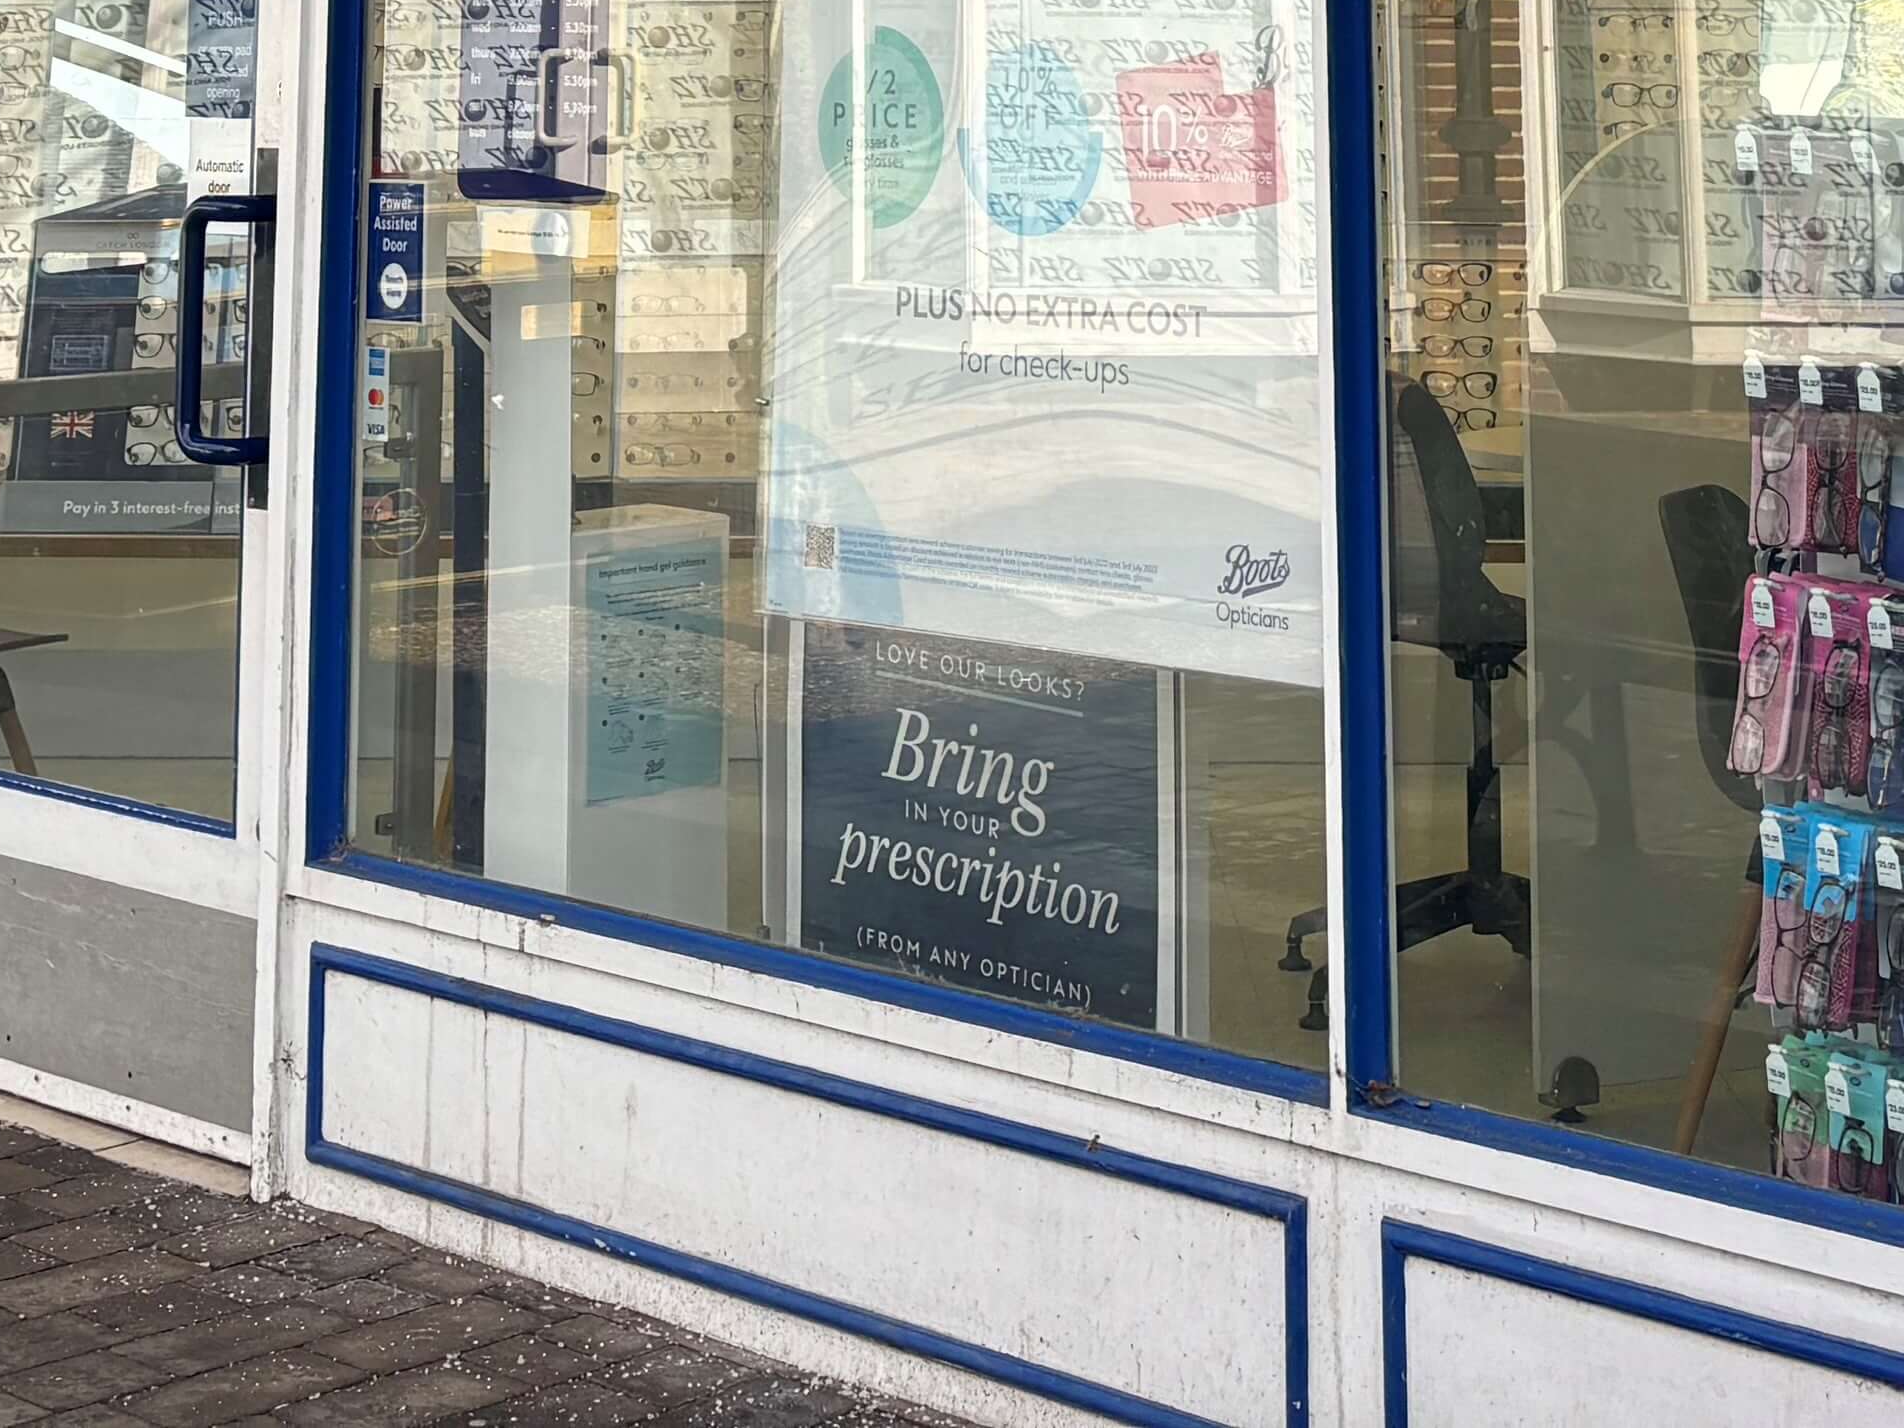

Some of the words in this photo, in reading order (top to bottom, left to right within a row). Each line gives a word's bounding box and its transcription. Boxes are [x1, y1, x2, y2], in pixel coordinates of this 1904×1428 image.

[471, 23, 490, 33] wed
[470, 73, 481, 85] fri
[563, 74, 597, 87] 5.30pm
[206, 87, 240, 101] opening
[833, 103, 918, 129] PICE
[196, 159, 244, 173] Automatic
[208, 180, 231, 194] door
[379, 192, 412, 211] Power
[374, 215, 417, 233] Assisted
[382, 237, 407, 252] Door
[896, 286, 962, 320] PLUS
[971, 292, 1017, 325] NO
[1026, 294, 1118, 331] EXTRA
[1127, 301, 1207, 338] COST
[959, 341, 993, 373] for
[999, 345, 1129, 393] check-ups
[367, 423, 385, 437] VISA
[63, 501, 90, 519] Pay
[94, 502, 106, 515] in
[110, 501, 119, 515] 3
[123, 501, 210, 515] interest-free
[215, 502, 240, 515] inst
[599, 566, 637, 579] Important
[1217, 544, 1290, 598] Boots
[1216, 601, 1289, 631] Opticians
[875, 641, 930, 672] LOVE
[939, 654, 986, 682] OUR
[998, 663, 1085, 703] LOOKS?
[882, 707, 1054, 838] Bring
[904, 797, 929, 823] IN
[938, 807, 1000, 840] YOUR
[830, 822, 1120, 935] prescription
[856, 925, 921, 958] (FROM
[930, 945, 972, 968] ANY
[980, 958, 1091, 1008] OPTICIAN)
